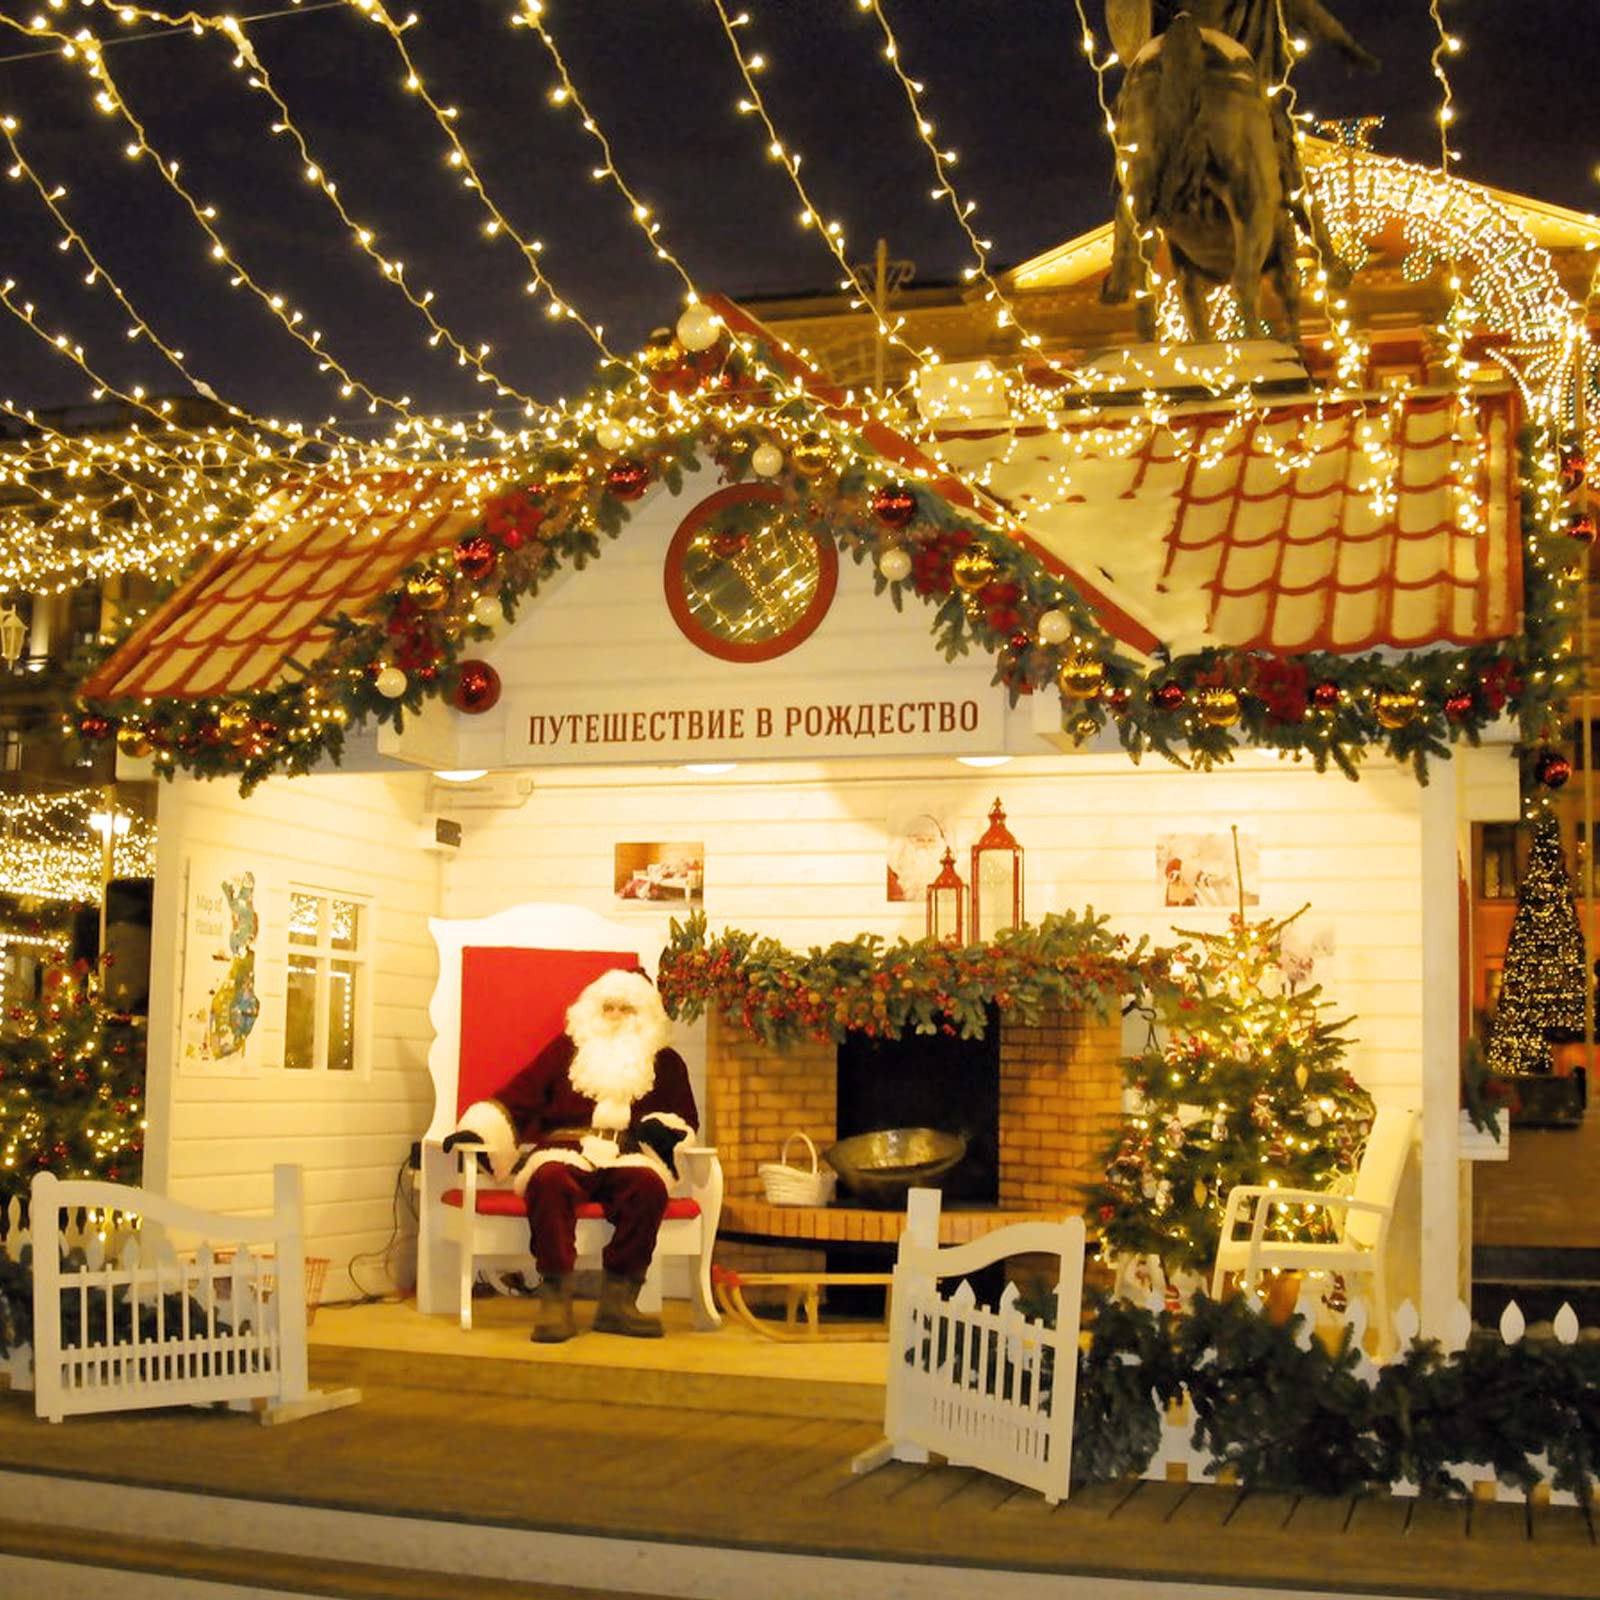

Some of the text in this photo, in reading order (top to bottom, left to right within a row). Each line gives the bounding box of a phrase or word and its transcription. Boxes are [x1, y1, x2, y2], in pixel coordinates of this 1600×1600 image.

[528, 700, 979, 746] ПУТЕШЕСТВИЕ В РОЖДЕСТВО
